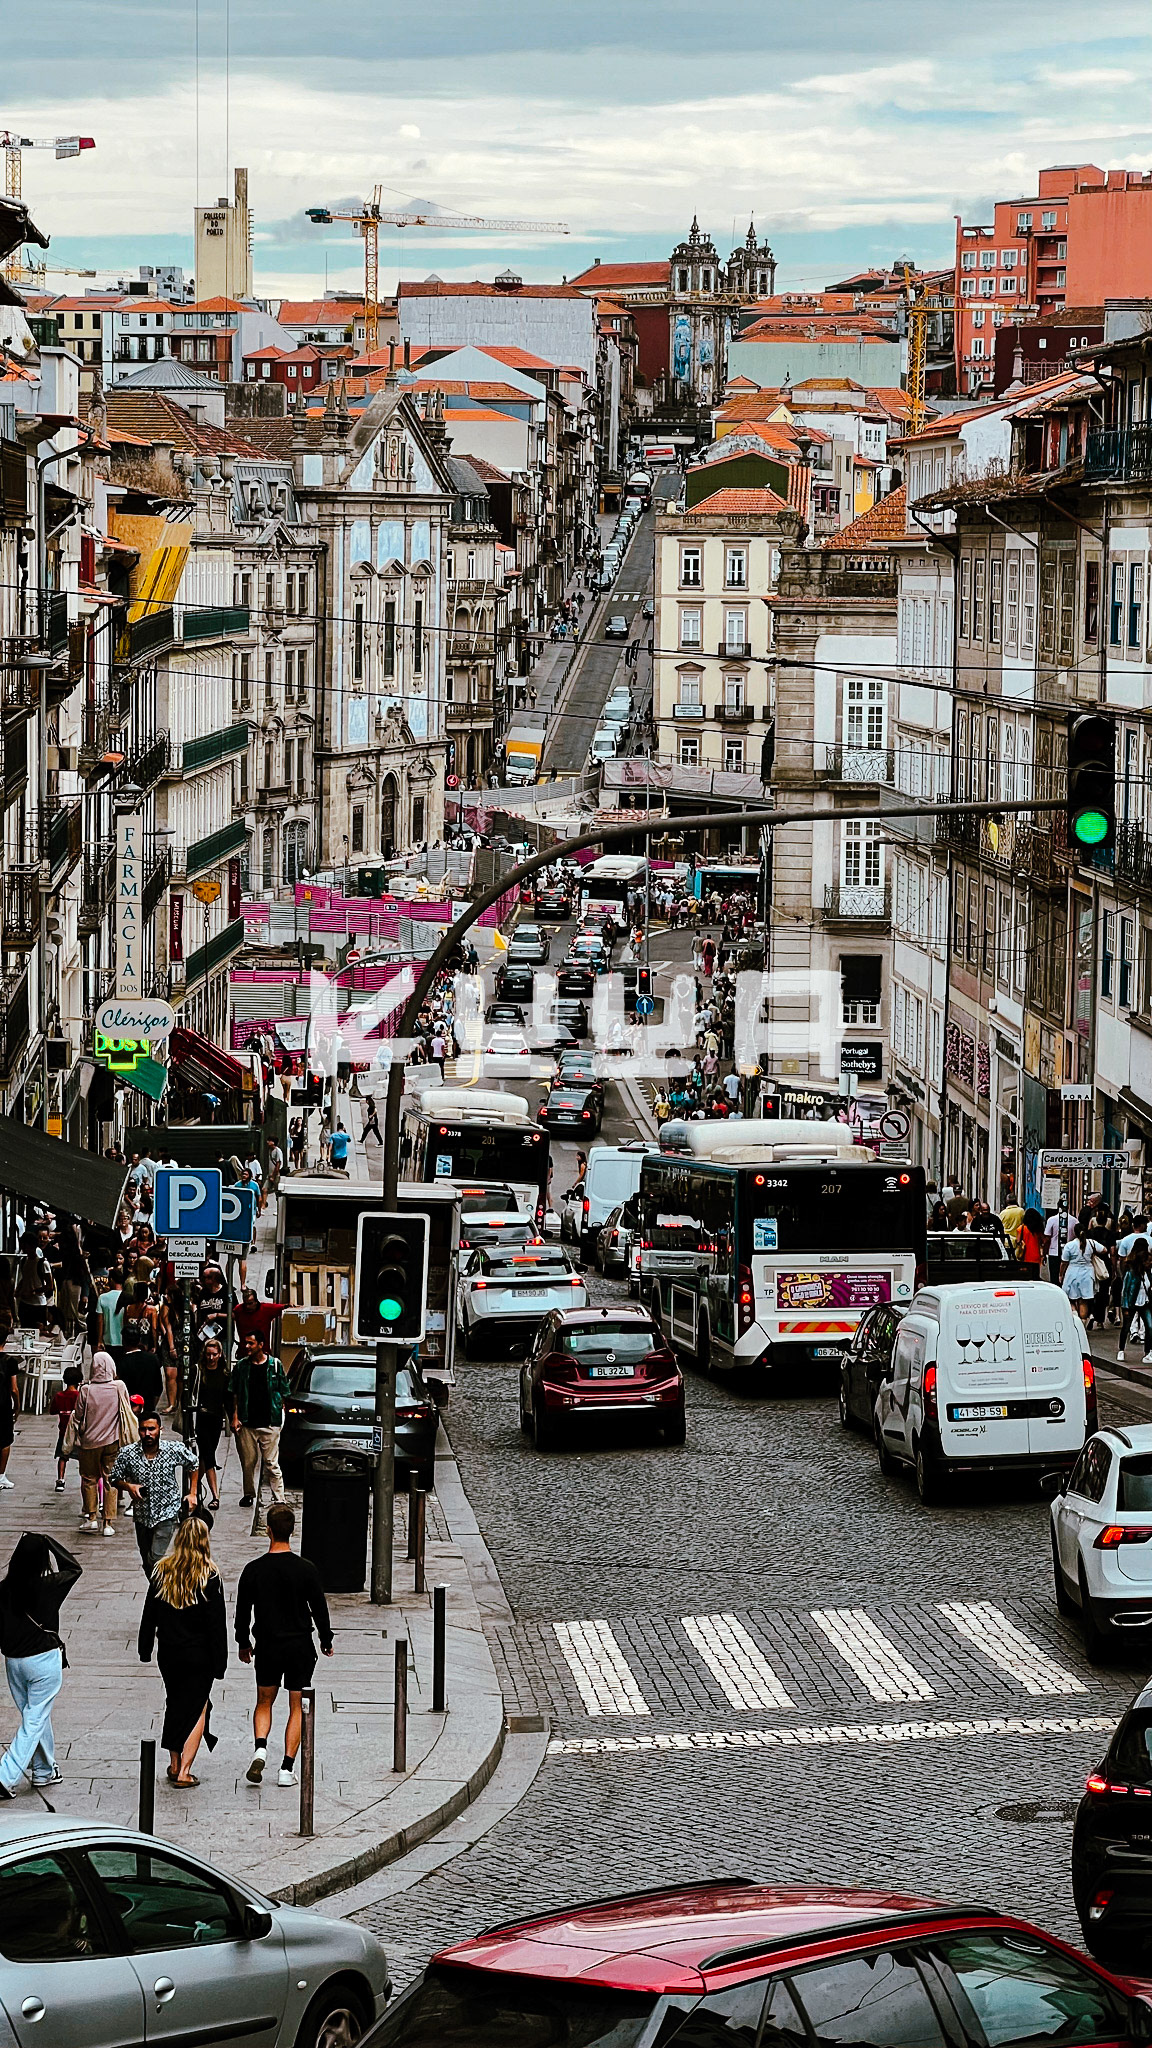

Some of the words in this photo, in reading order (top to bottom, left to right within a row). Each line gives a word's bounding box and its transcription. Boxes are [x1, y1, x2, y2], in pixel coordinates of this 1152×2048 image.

[206, 228, 224, 236] PORTO
[120, 827, 139, 977] FARMÁCIA
[120, 984, 138, 993] DOS
[101, 1009, 170, 1034] Clérigos
[841, 1048, 869, 1056] Portugal
[841, 1060, 877, 1070] Sotheby's
[784, 1092, 824, 1106] makro
[481, 1135, 496, 1145] 201
[766, 1179, 788, 1187] 3342
[821, 1184, 842, 1194] 207
[169, 1175, 207, 1229] P
[819, 1255, 849, 1263] MAN
[597, 1366, 608, 1376] BL
[608, 1366, 618, 1375] 32
[618, 1366, 629, 1375] ZL
